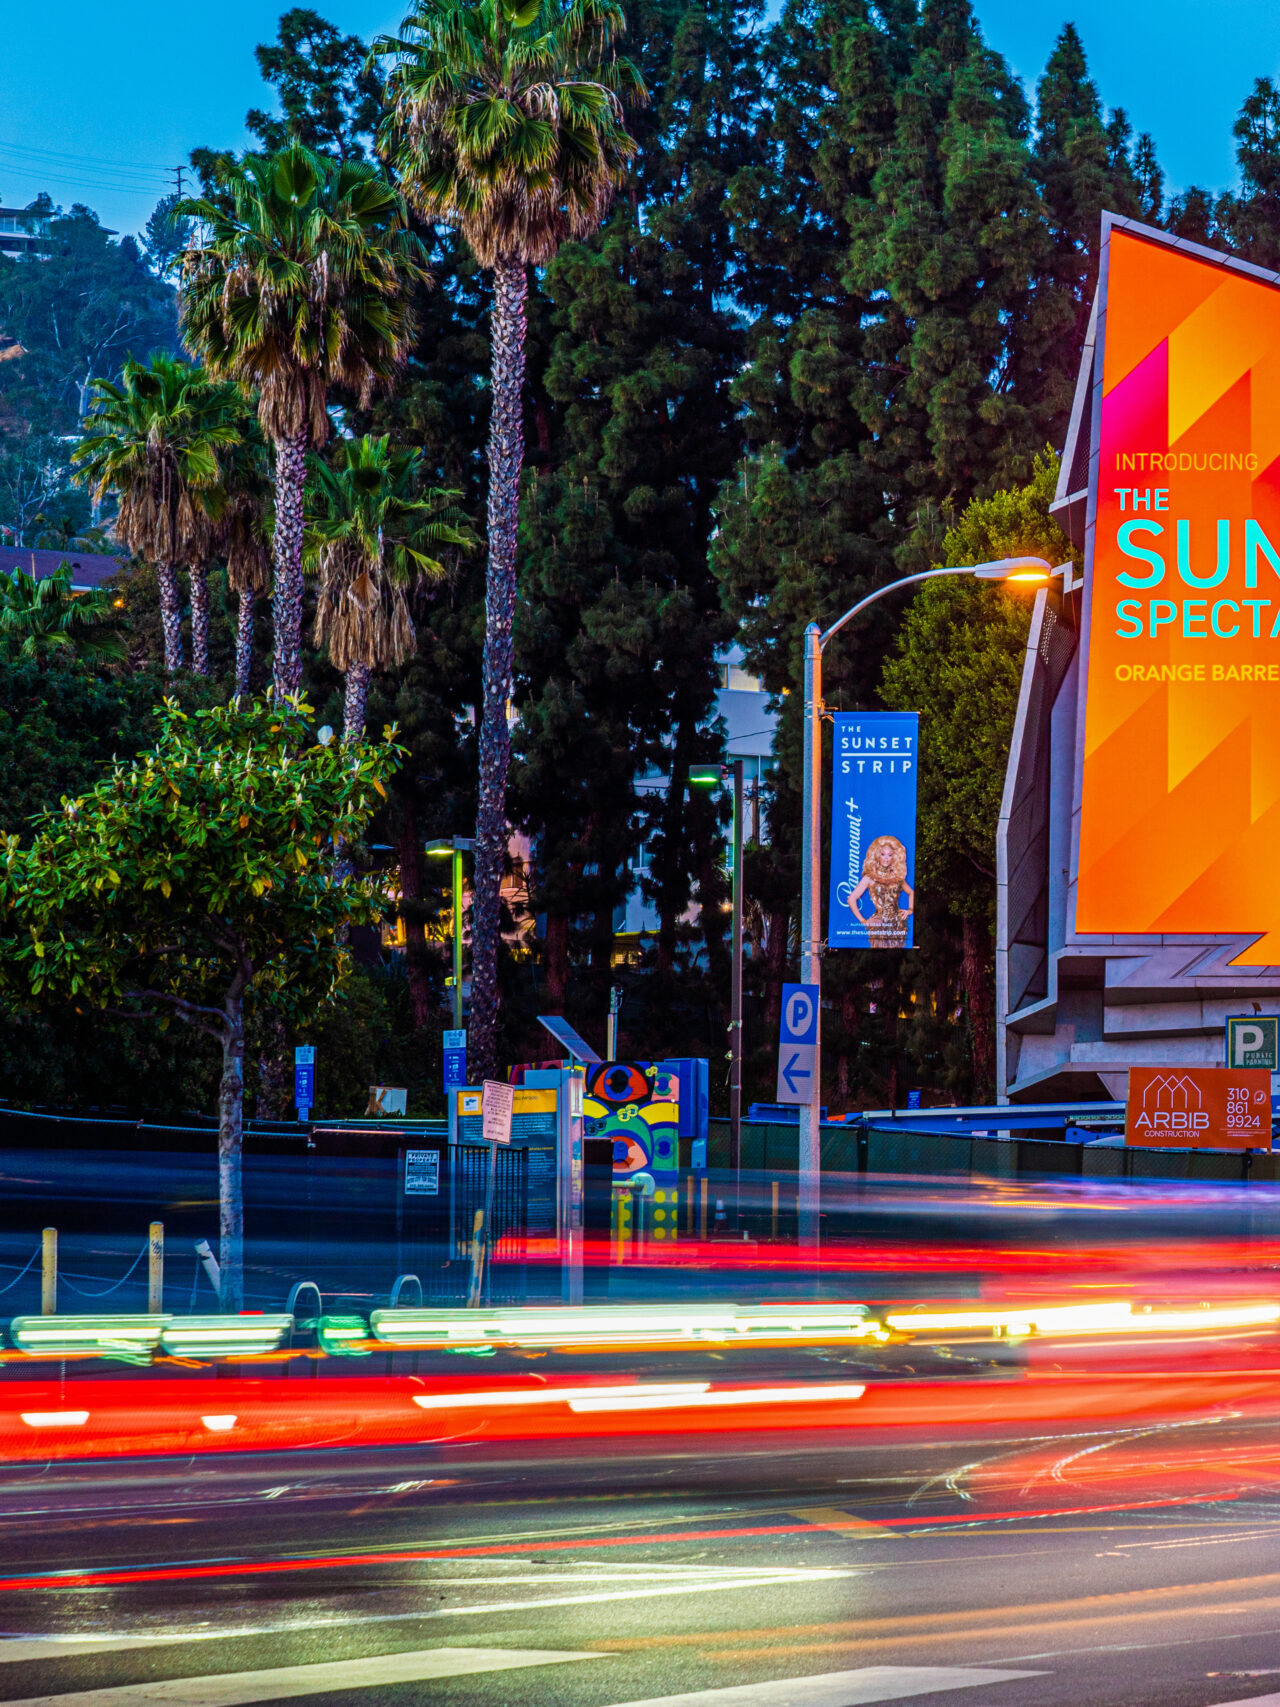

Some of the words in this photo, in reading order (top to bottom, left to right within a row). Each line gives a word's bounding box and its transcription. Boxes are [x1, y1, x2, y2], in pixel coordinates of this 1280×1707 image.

[1115, 453, 1258, 471] INTRODUCING
[1114, 489, 1169, 511] THE
[1115, 664, 1206, 682] ORANGE
[841, 737, 912, 749] SUNSET
[841, 760, 912, 774] STRIP
[837, 797, 862, 911] Paramount+
[792, 1000, 808, 1028] P
[1235, 1024, 1264, 1066] P
[1227, 1088, 1250, 1101] 310
[1226, 1101, 1249, 1114] 861
[1135, 1111, 1210, 1129] ARBIB
[1226, 1115, 1261, 1128] 9924
[1144, 1130, 1200, 1138] CONSTRUCTION
